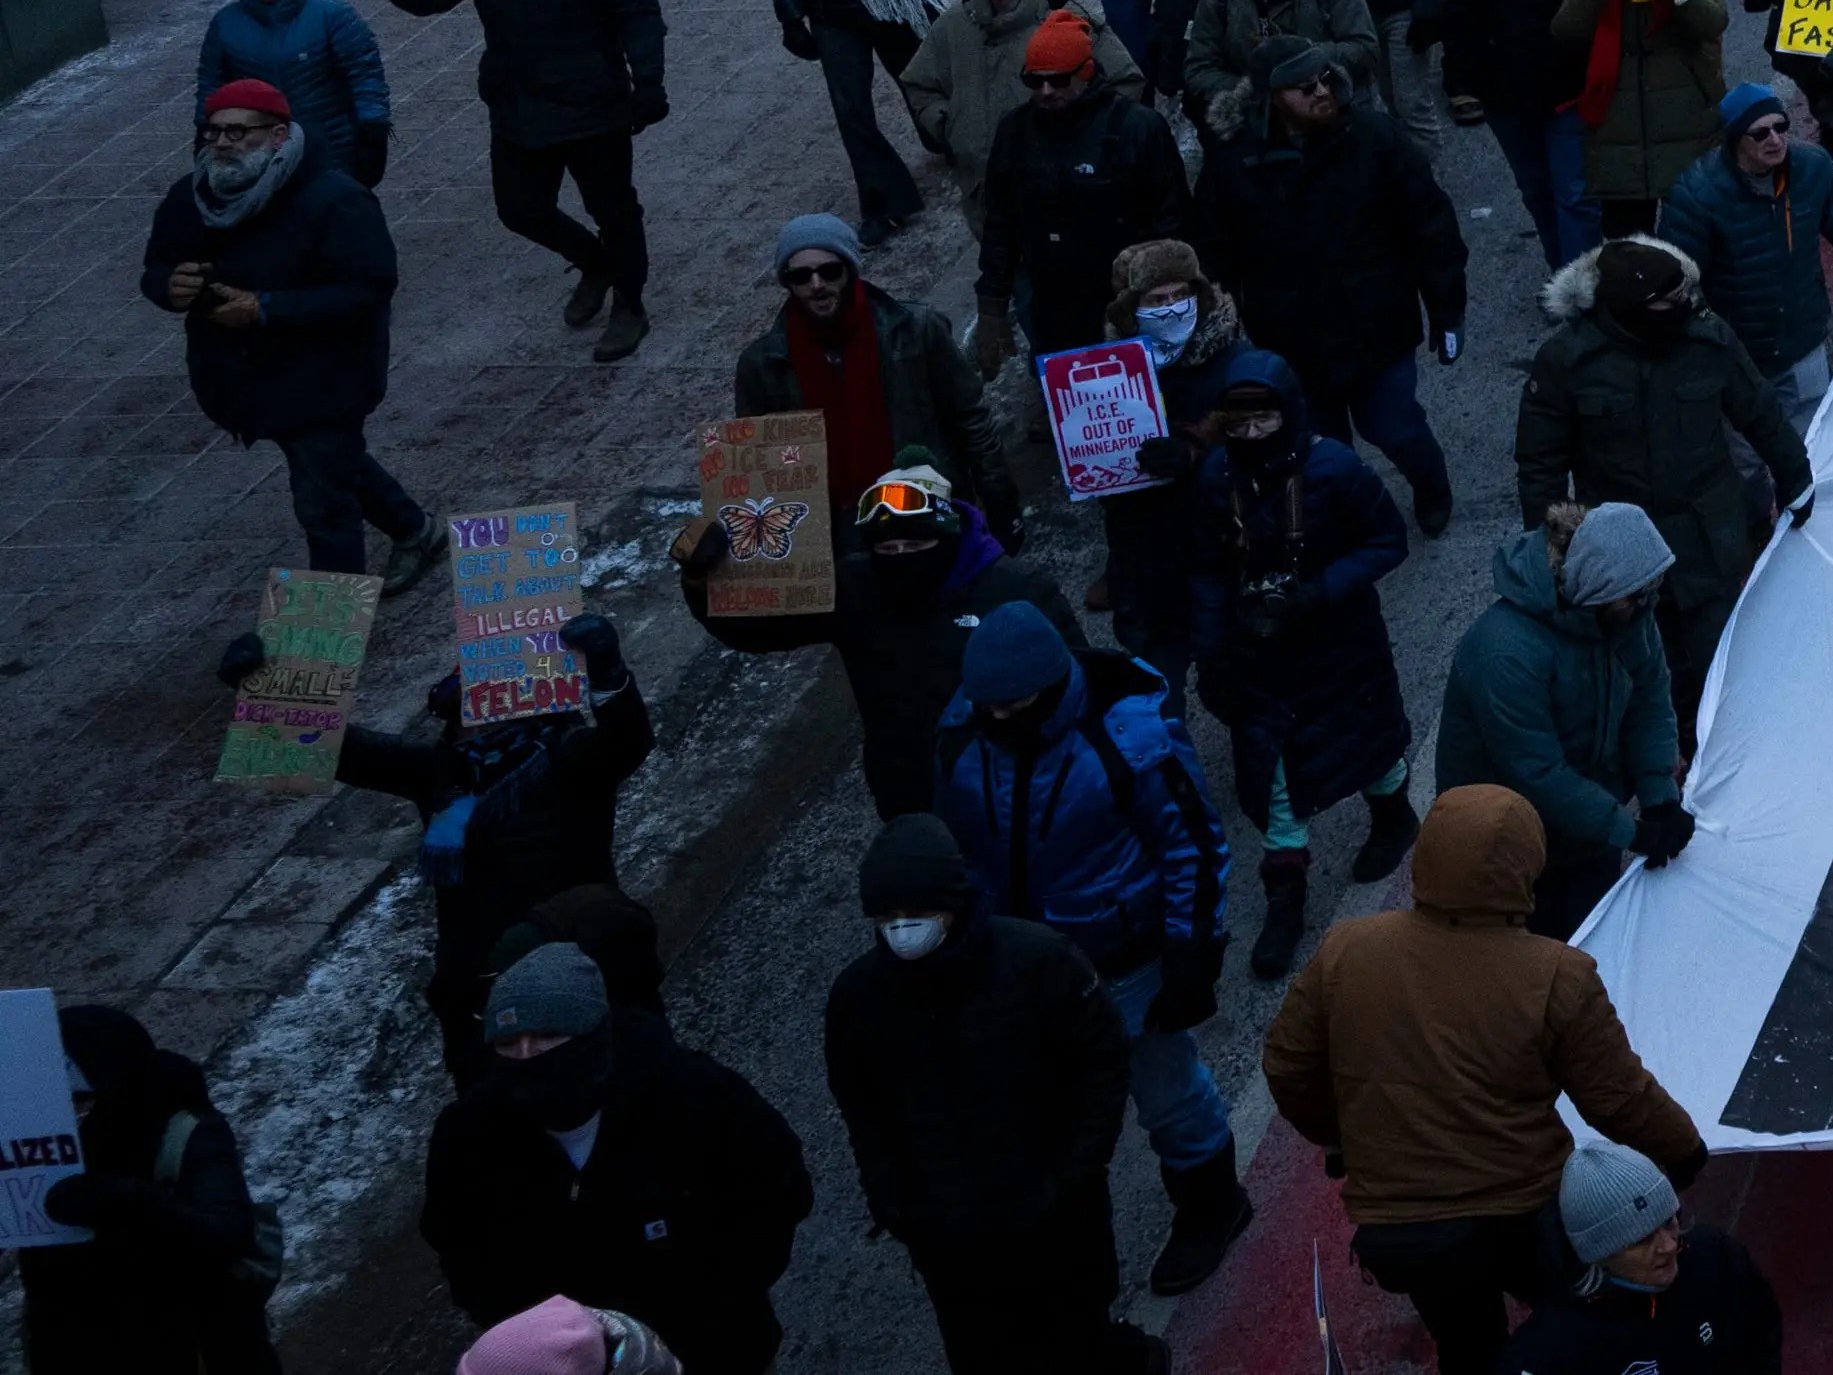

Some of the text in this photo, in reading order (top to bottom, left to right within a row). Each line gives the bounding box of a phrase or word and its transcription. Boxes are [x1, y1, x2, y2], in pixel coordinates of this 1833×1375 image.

[1087, 403, 1126, 422] I.C.E.
[1082, 419, 1136, 442] OUT OF
[1069, 430, 1158, 461] MINNEAPOLIS
[731, 449, 770, 474] ICE
[762, 467, 820, 495] FEAR
[451, 517, 510, 548] YOU
[458, 549, 513, 576] GET
[458, 572, 579, 602] TALK ABOUT
[460, 636, 522, 660] WHEN
[536, 655, 550, 675] 4
[468, 677, 582, 720] FELON
